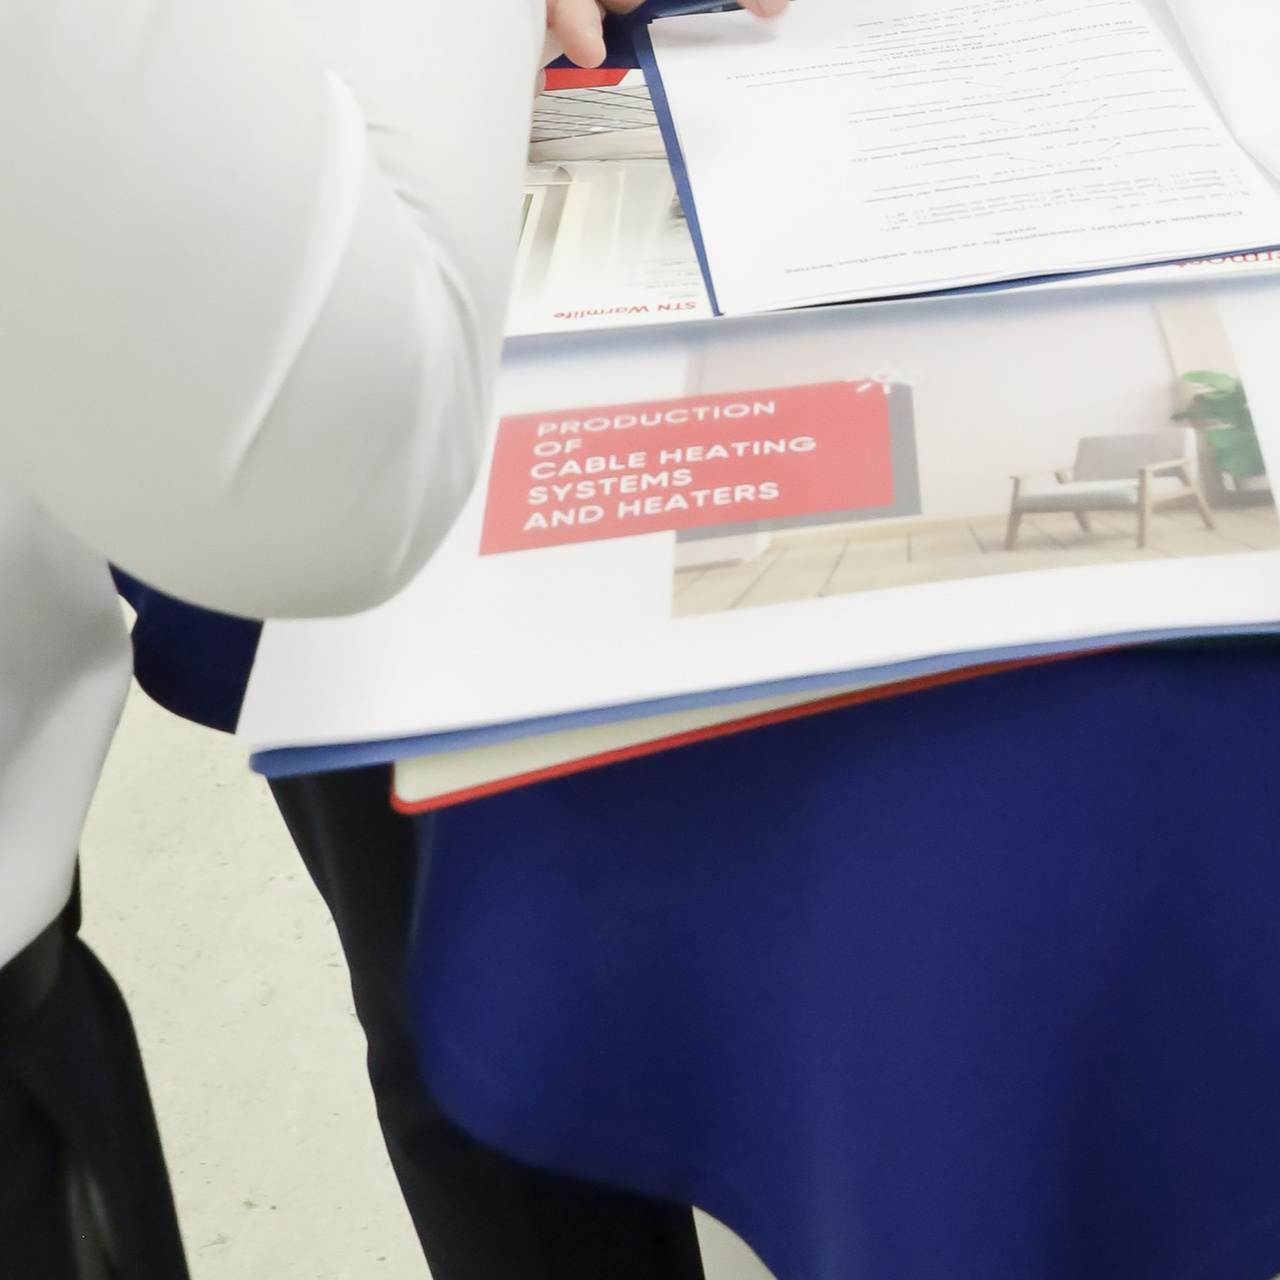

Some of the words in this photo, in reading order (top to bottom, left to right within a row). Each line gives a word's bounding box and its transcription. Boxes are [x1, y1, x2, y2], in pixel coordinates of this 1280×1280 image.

[552, 304, 649, 320] Warmlife
[656, 301, 697, 312] STN
[536, 399, 777, 439] PRODUCTION
[529, 450, 647, 481] CABLE
[658, 435, 818, 467] HEATING
[532, 437, 583, 458] OF
[526, 467, 694, 506] SYSTEMS
[521, 504, 606, 532] AND
[616, 481, 781, 520] HEATERS
